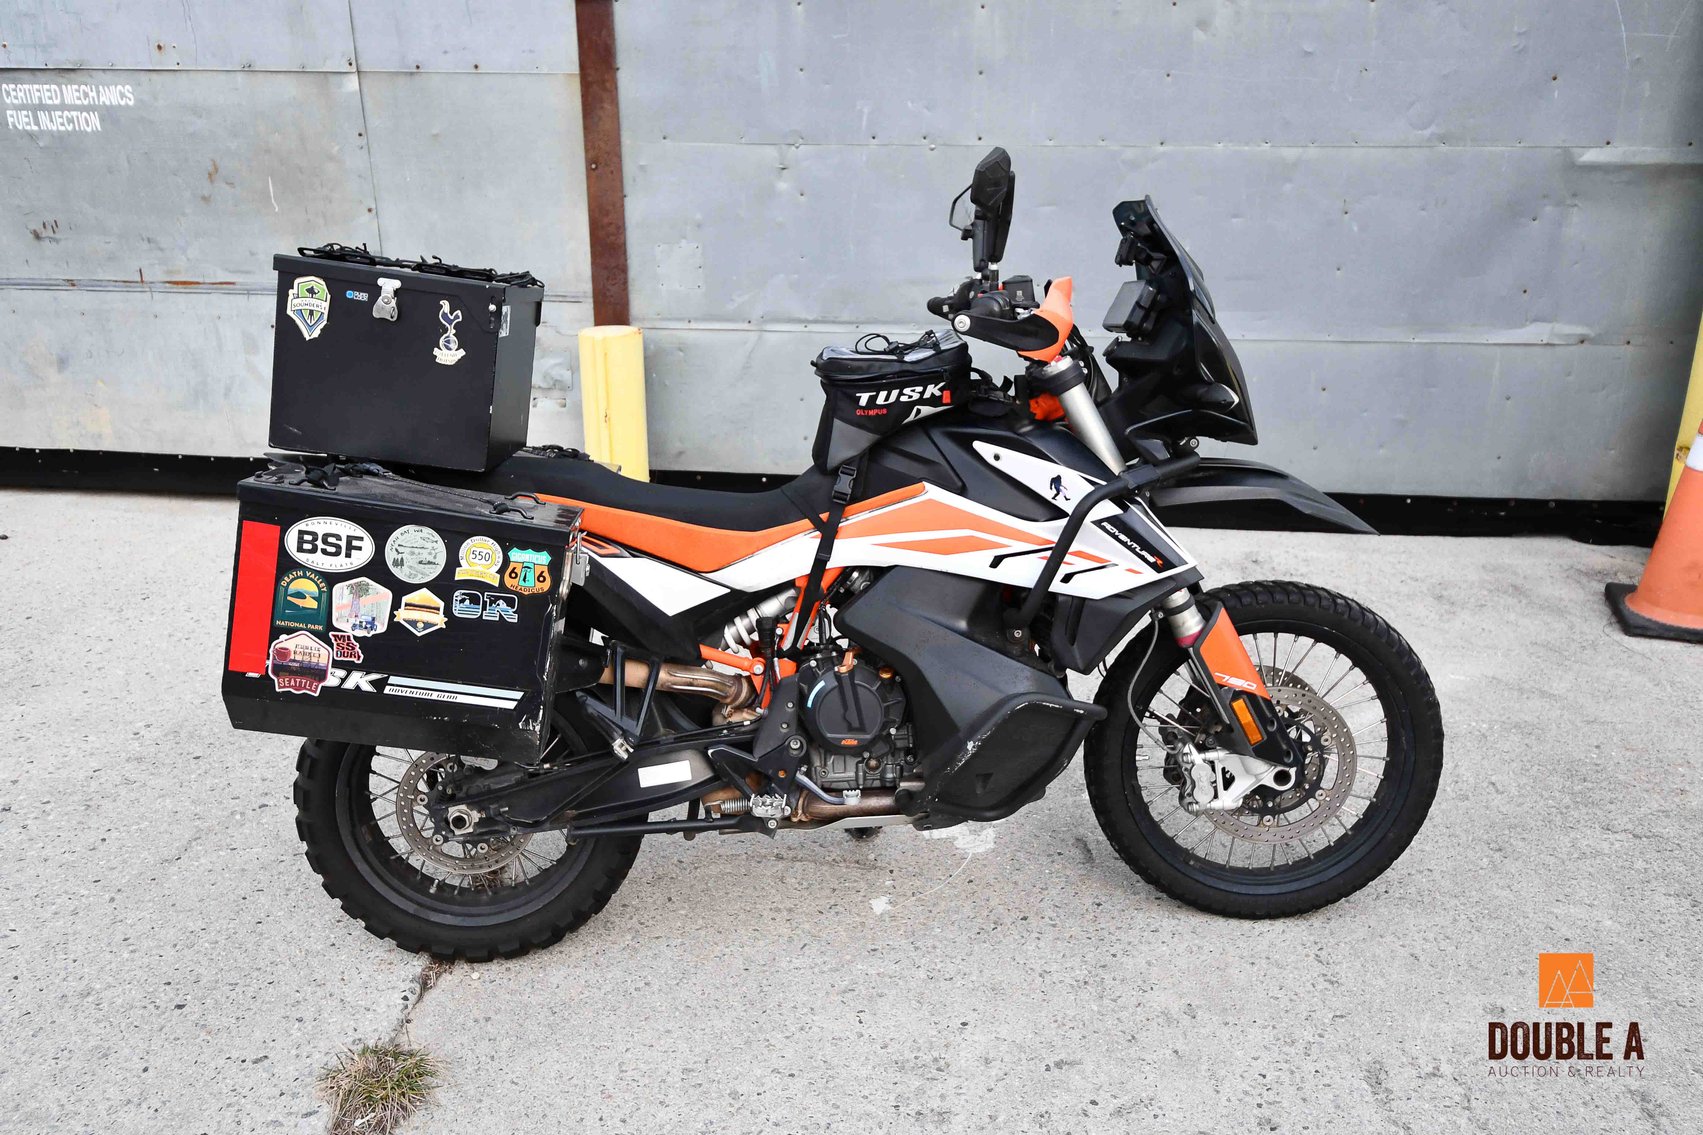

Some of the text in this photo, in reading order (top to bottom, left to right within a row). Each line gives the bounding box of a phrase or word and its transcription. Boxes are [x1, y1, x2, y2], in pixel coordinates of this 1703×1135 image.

[1, 84, 135, 106] CERTIFIED MECHANICS
[6, 110, 101, 132] FUEL INJECTION
[856, 382, 946, 407] TUSK
[856, 408, 887, 416] OLYMPUS
[296, 529, 364, 559] BSF
[1101, 521, 1157, 563] ADVENTURE
[471, 549, 491, 562] 550
[280, 570, 327, 592] DEATH VALLEY
[276, 620, 307, 629] NATIONAL
[279, 678, 318, 691] SEATTLE
